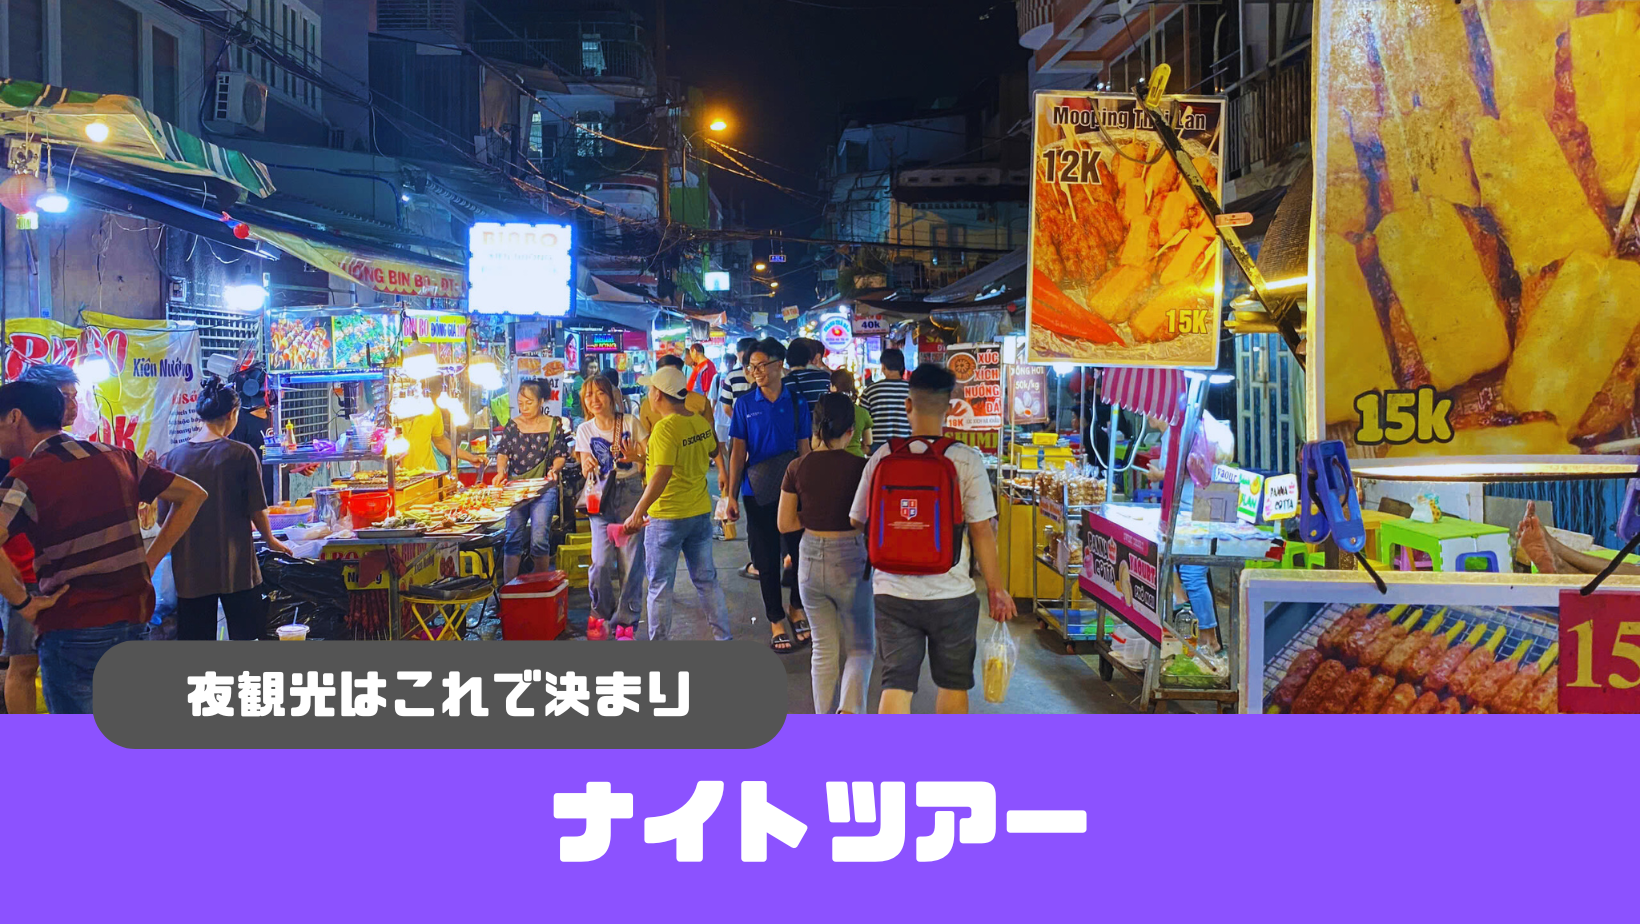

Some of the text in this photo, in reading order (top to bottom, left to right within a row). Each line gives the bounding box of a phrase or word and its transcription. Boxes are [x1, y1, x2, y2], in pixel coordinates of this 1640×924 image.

[1053, 106, 1129, 130] Mooping
[1133, 107, 1170, 129] Thi
[1043, 149, 1102, 184] 12K
[388, 269, 411, 288] BIN
[861, 320, 880, 329] 40k
[1165, 308, 1209, 334] 15K
[977, 349, 999, 364] XÚC
[973, 365, 999, 380] XÍCH
[1354, 384, 1456, 445] 15k
